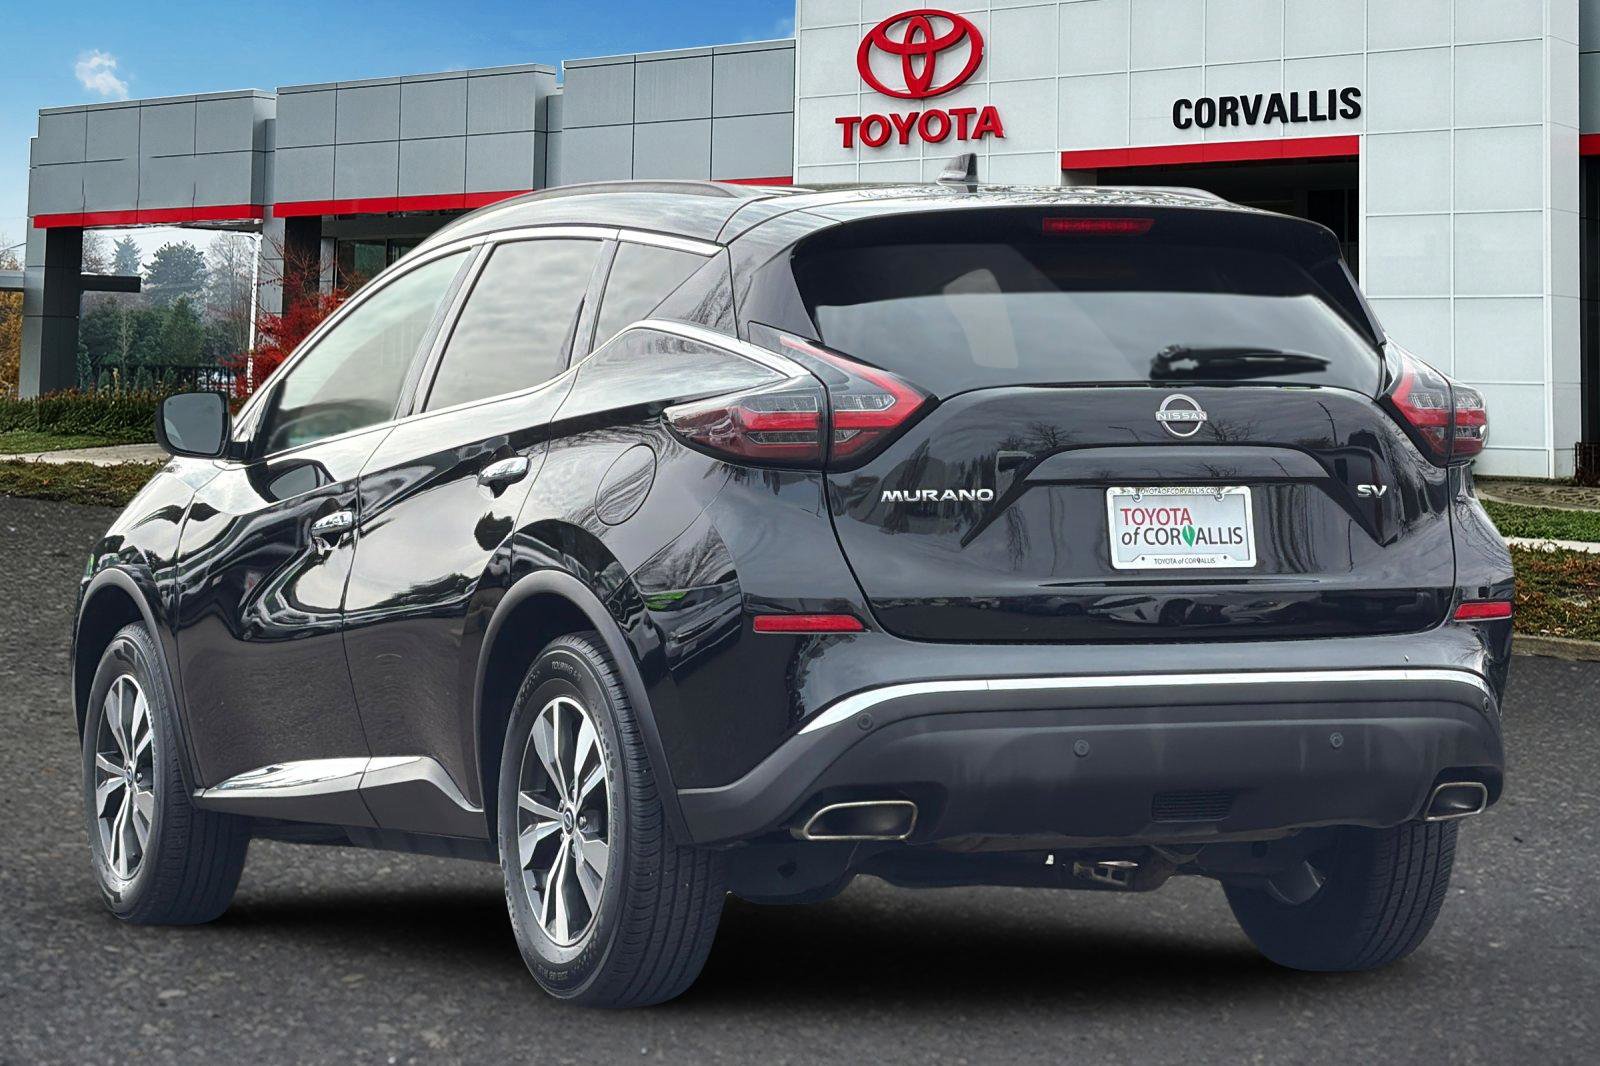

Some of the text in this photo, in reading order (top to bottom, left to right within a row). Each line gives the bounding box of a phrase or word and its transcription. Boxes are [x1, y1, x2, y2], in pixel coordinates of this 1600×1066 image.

[1172, 86, 1362, 129] CORVALLIS
[835, 105, 1006, 149] TOYOTA
[1157, 411, 1207, 421] NISSAN
[880, 488, 994, 503] MURANO
[1357, 484, 1388, 499] SV
[1120, 507, 1193, 526] TOYOTA
[1121, 526, 1140, 546] of
[1153, 557, 1178, 565] TOYOTA
[1178, 557, 1184, 565] of
